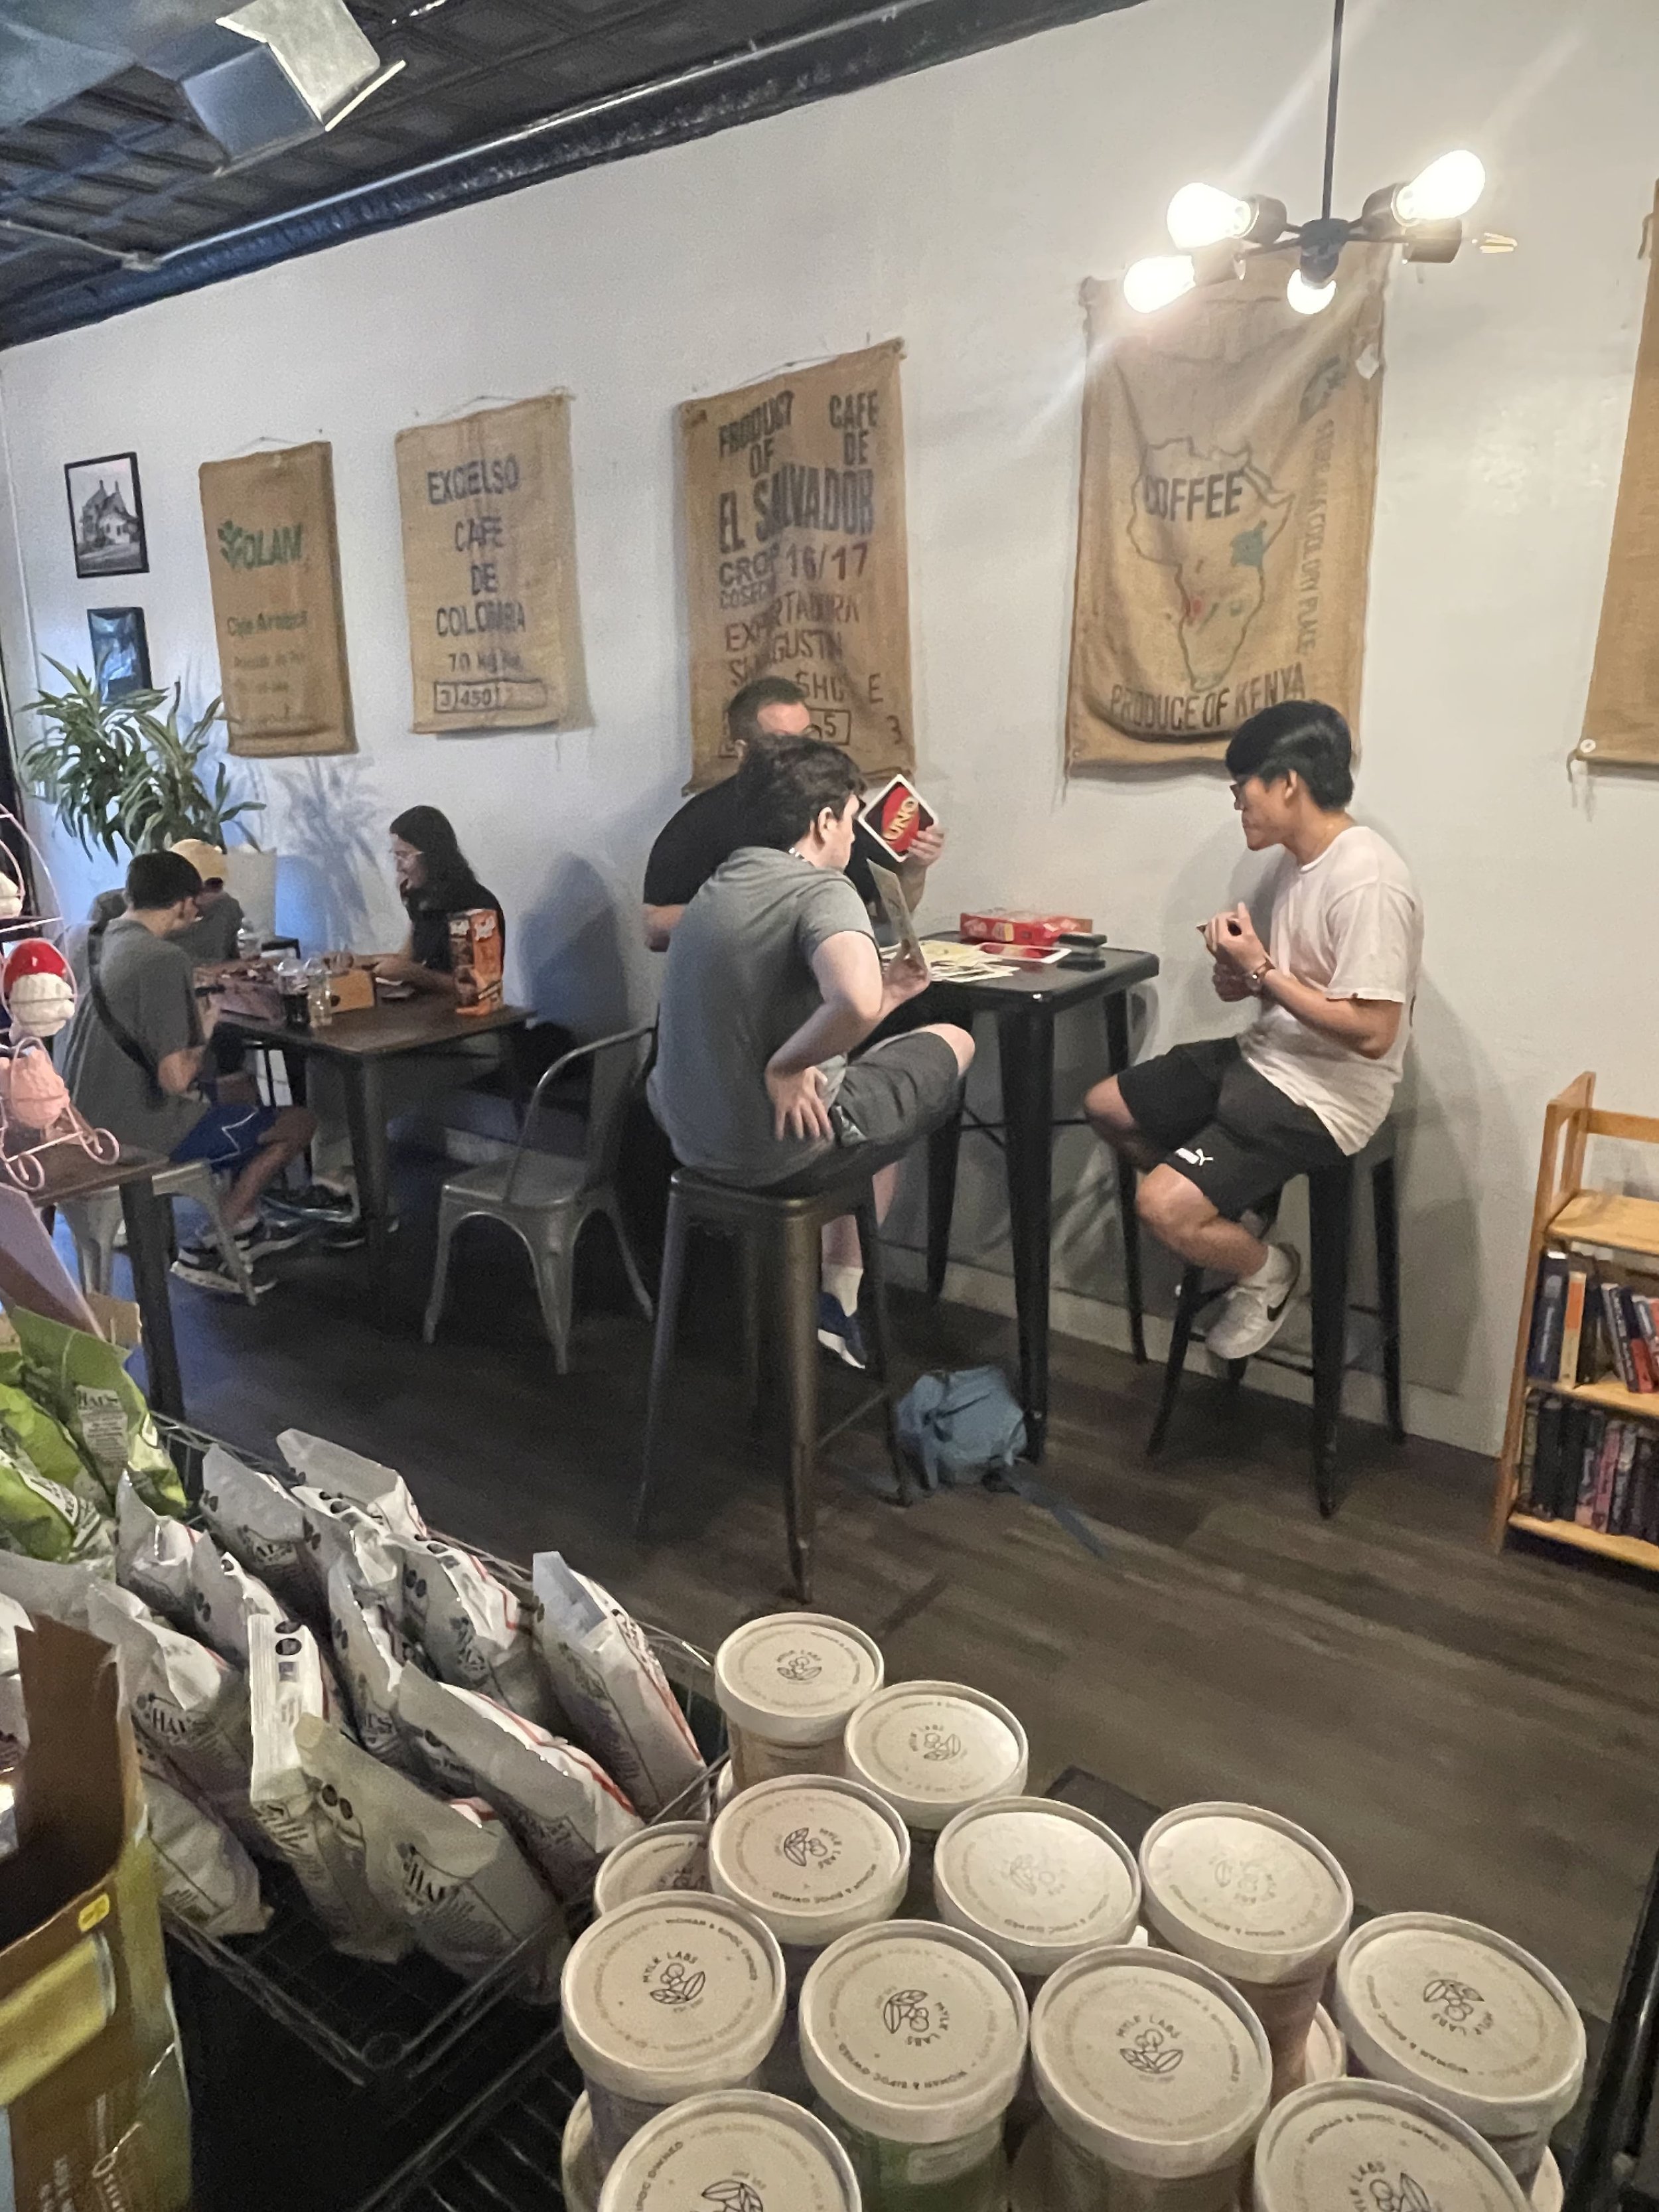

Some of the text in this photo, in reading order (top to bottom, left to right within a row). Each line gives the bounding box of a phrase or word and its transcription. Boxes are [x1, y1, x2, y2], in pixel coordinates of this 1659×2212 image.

[829, 390, 879, 430] CAFE
[749, 439, 775, 479] OF
[843, 431, 868, 466] DE
[427, 455, 520, 505] EXCELSO
[1145, 469, 1243, 520] COFFEE
[719, 489, 745, 554] EL
[470, 563, 498, 595] DE
[786, 542, 869, 581] 16/17
[1110, 662, 1306, 731] PRODUCE OF KENYA
[881, 796, 919, 842] UNO
[666, 1951, 699, 1964] LABS
[906, 2032, 941, 2047] LABS
